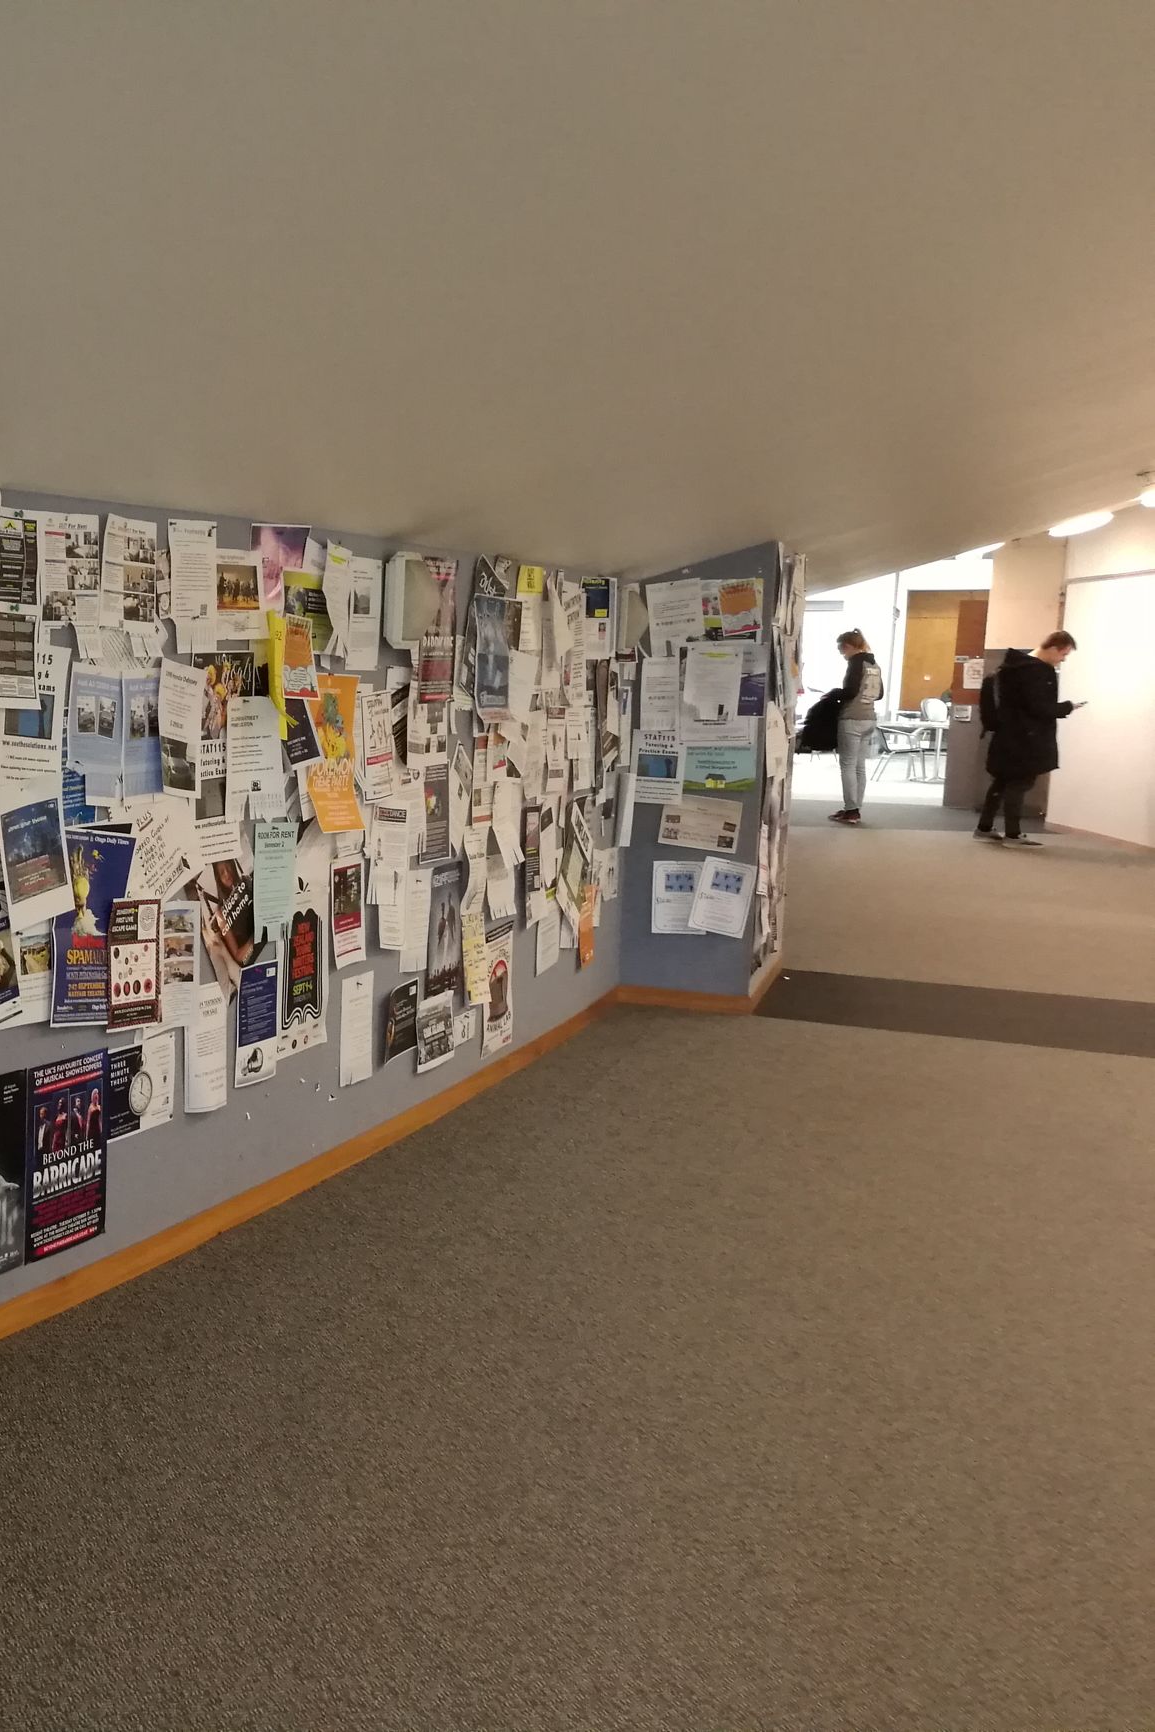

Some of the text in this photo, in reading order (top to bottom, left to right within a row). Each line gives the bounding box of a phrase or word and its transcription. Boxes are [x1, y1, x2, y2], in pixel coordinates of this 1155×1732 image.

[38, 684, 56, 692] xams
[271, 831, 281, 839] FOR
[281, 830, 295, 839] RENT
[238, 882, 246, 894] to
[222, 913, 234, 936] call
[34, 1052, 103, 1079] THE UK'S FAVOURITE CONCERT
[111, 1060, 126, 1070] THREE
[43, 1072, 65, 1084] MUSICAL
[65, 1061, 103, 1077] SHOWSTOPPERS
[110, 1068, 130, 1078] MINUTE
[110, 1077, 128, 1087] THESIS
[42, 1139, 94, 1165] BEYOND THE
[32, 1149, 102, 1199] BARRICADE
